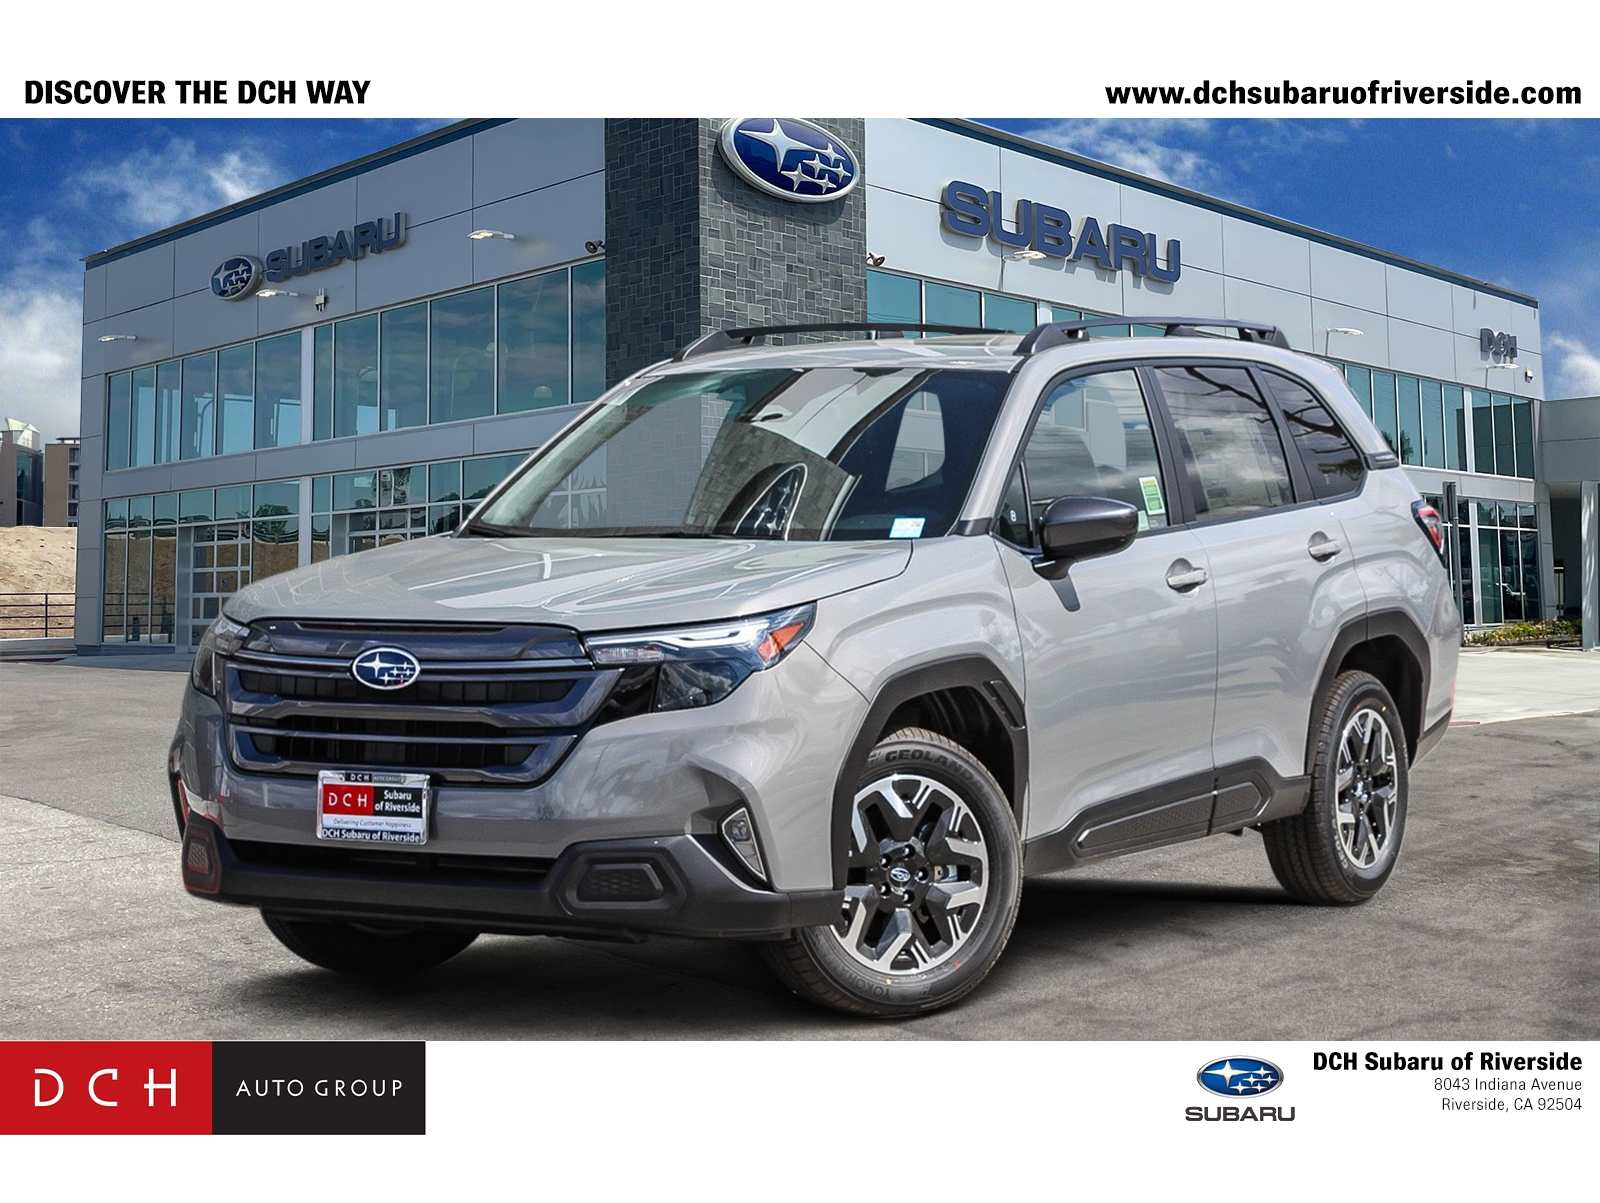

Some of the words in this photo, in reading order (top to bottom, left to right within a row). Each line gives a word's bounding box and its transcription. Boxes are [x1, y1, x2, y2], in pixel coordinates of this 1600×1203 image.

[942, 180, 1182, 284] SUBARU
[265, 212, 407, 282] SUBARU
[328, 792, 368, 808] DCH
[384, 789, 412, 800] Subaru
[374, 801, 384, 811] of
[385, 801, 421, 813] Riverside
[322, 828, 340, 838] DCH
[341, 829, 370, 840] Subaru
[371, 830, 381, 841] of
[382, 831, 420, 843] Riverside
